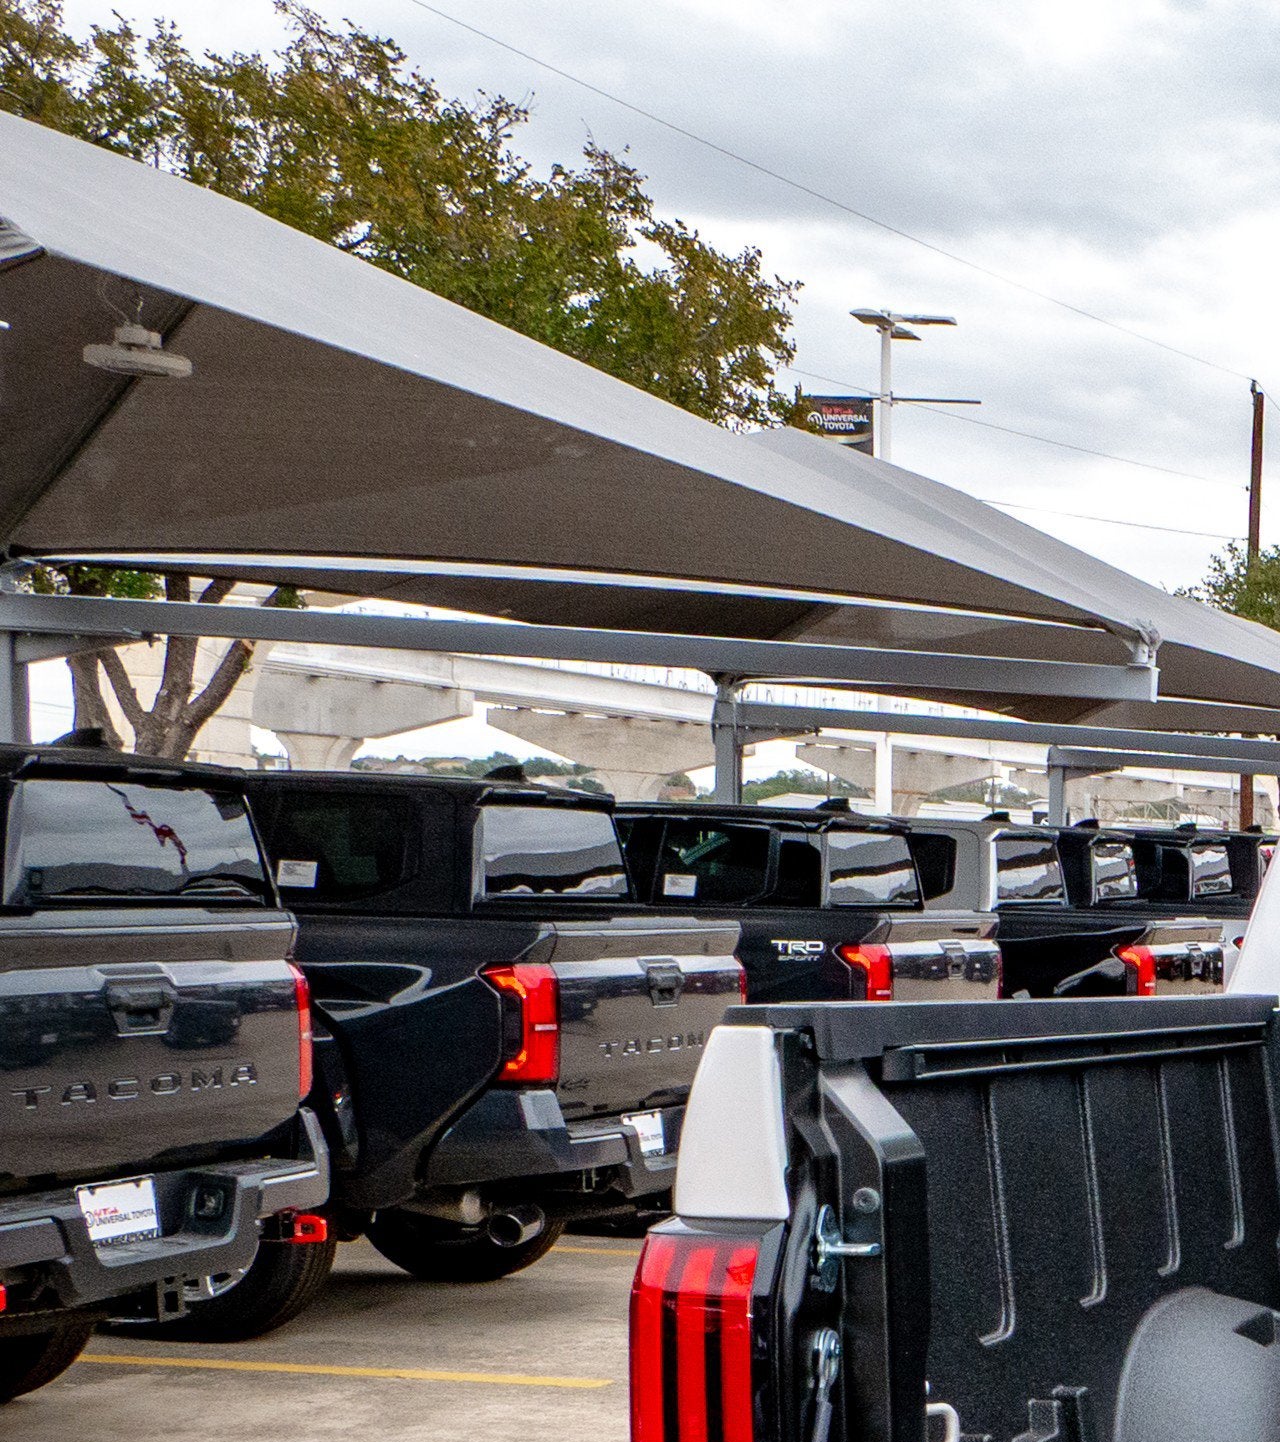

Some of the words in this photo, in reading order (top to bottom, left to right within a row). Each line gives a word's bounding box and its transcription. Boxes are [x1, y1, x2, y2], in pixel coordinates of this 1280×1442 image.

[822, 413, 869, 423] UNIVERSAL
[823, 421, 855, 431] TOYOTA
[770, 939, 825, 955] TRD
[599, 1032, 703, 1058] TACOM
[11, 1061, 258, 1110] TACOMA
